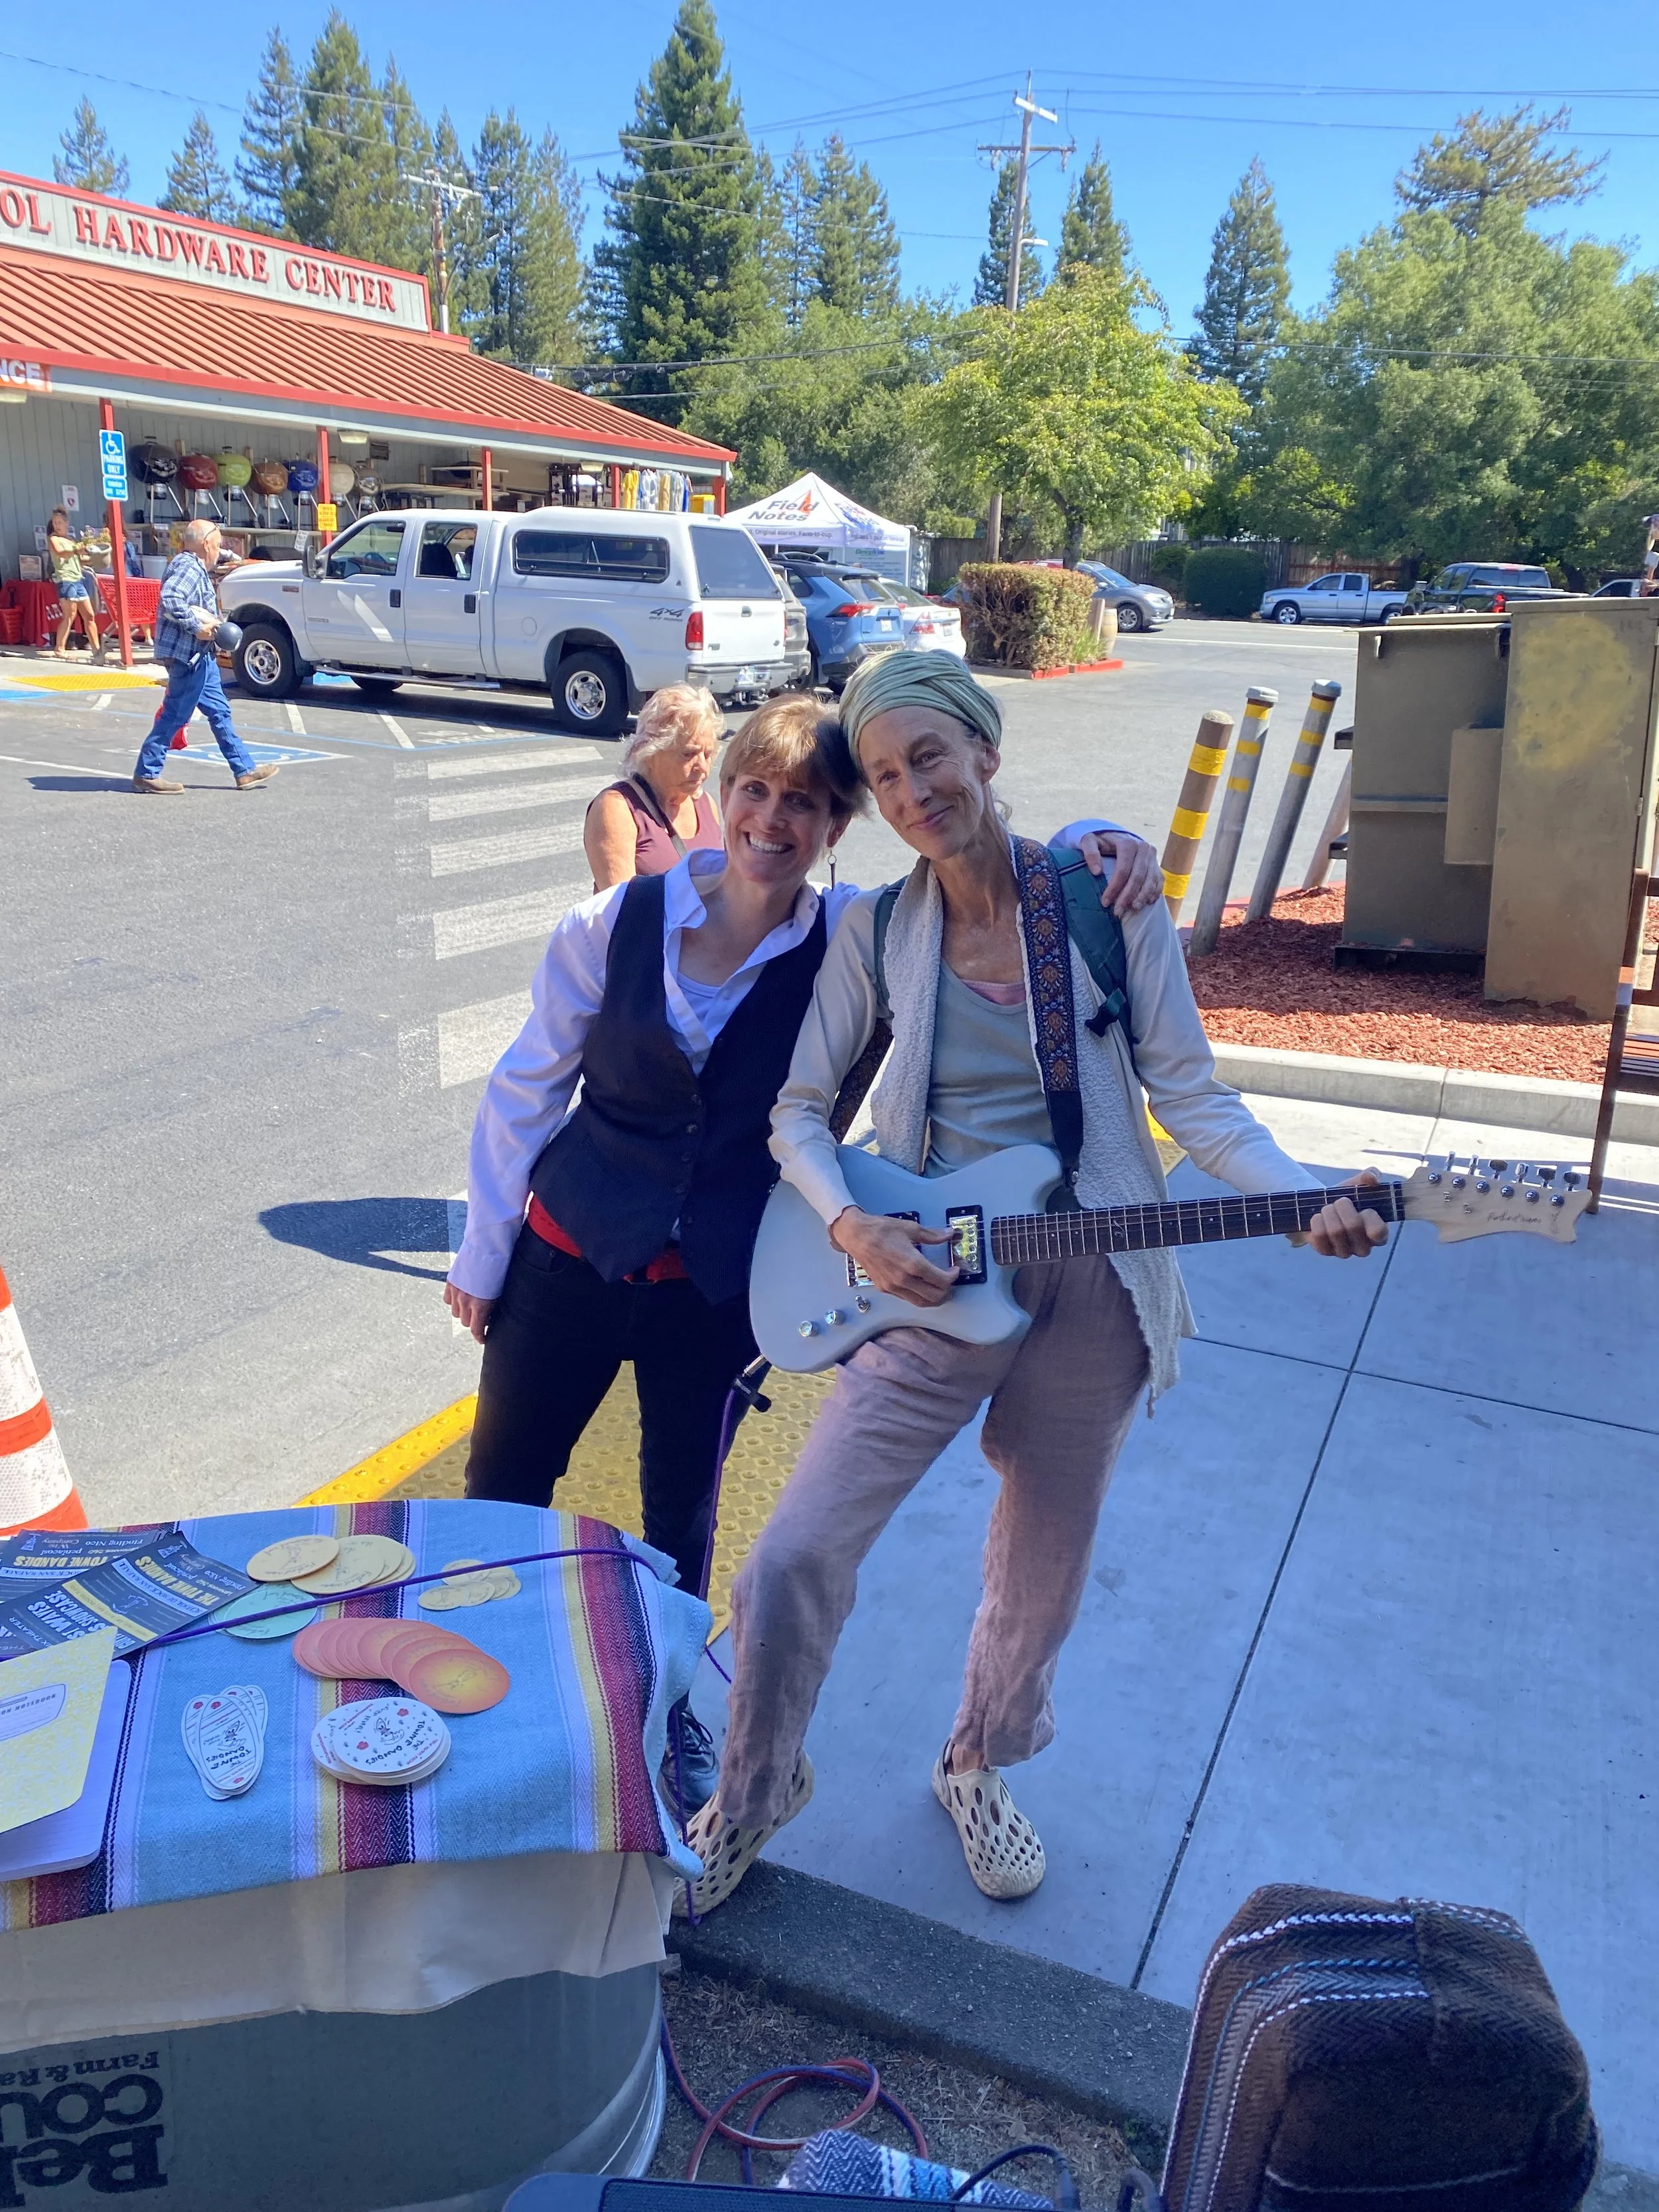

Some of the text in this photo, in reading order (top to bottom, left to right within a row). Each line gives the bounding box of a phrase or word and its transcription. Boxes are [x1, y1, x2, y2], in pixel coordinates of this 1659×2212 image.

[72, 204, 269, 283] HARDWARE
[285, 256, 397, 313] CENTER
[747, 510, 809, 522] Notes
[766, 500, 820, 512] Field
[108, 1538, 143, 1547] Finding
[13, 1556, 108, 1567] TOWNE DANDIES
[135, 1556, 179, 1586] DANDIES
[27, 1600, 73, 1633] WAVES
[44, 1590, 100, 1627] SHOWCASE
[9, 1617, 42, 1642] THEATER
[365, 1720, 425, 1765] TOWNE DANDIES
[412, 1739, 425, 1751] THE
[206, 1745, 245, 1763] DANDIES
[210, 1749, 252, 1770] TOWNE
[73, 2051, 159, 2075] Farm
